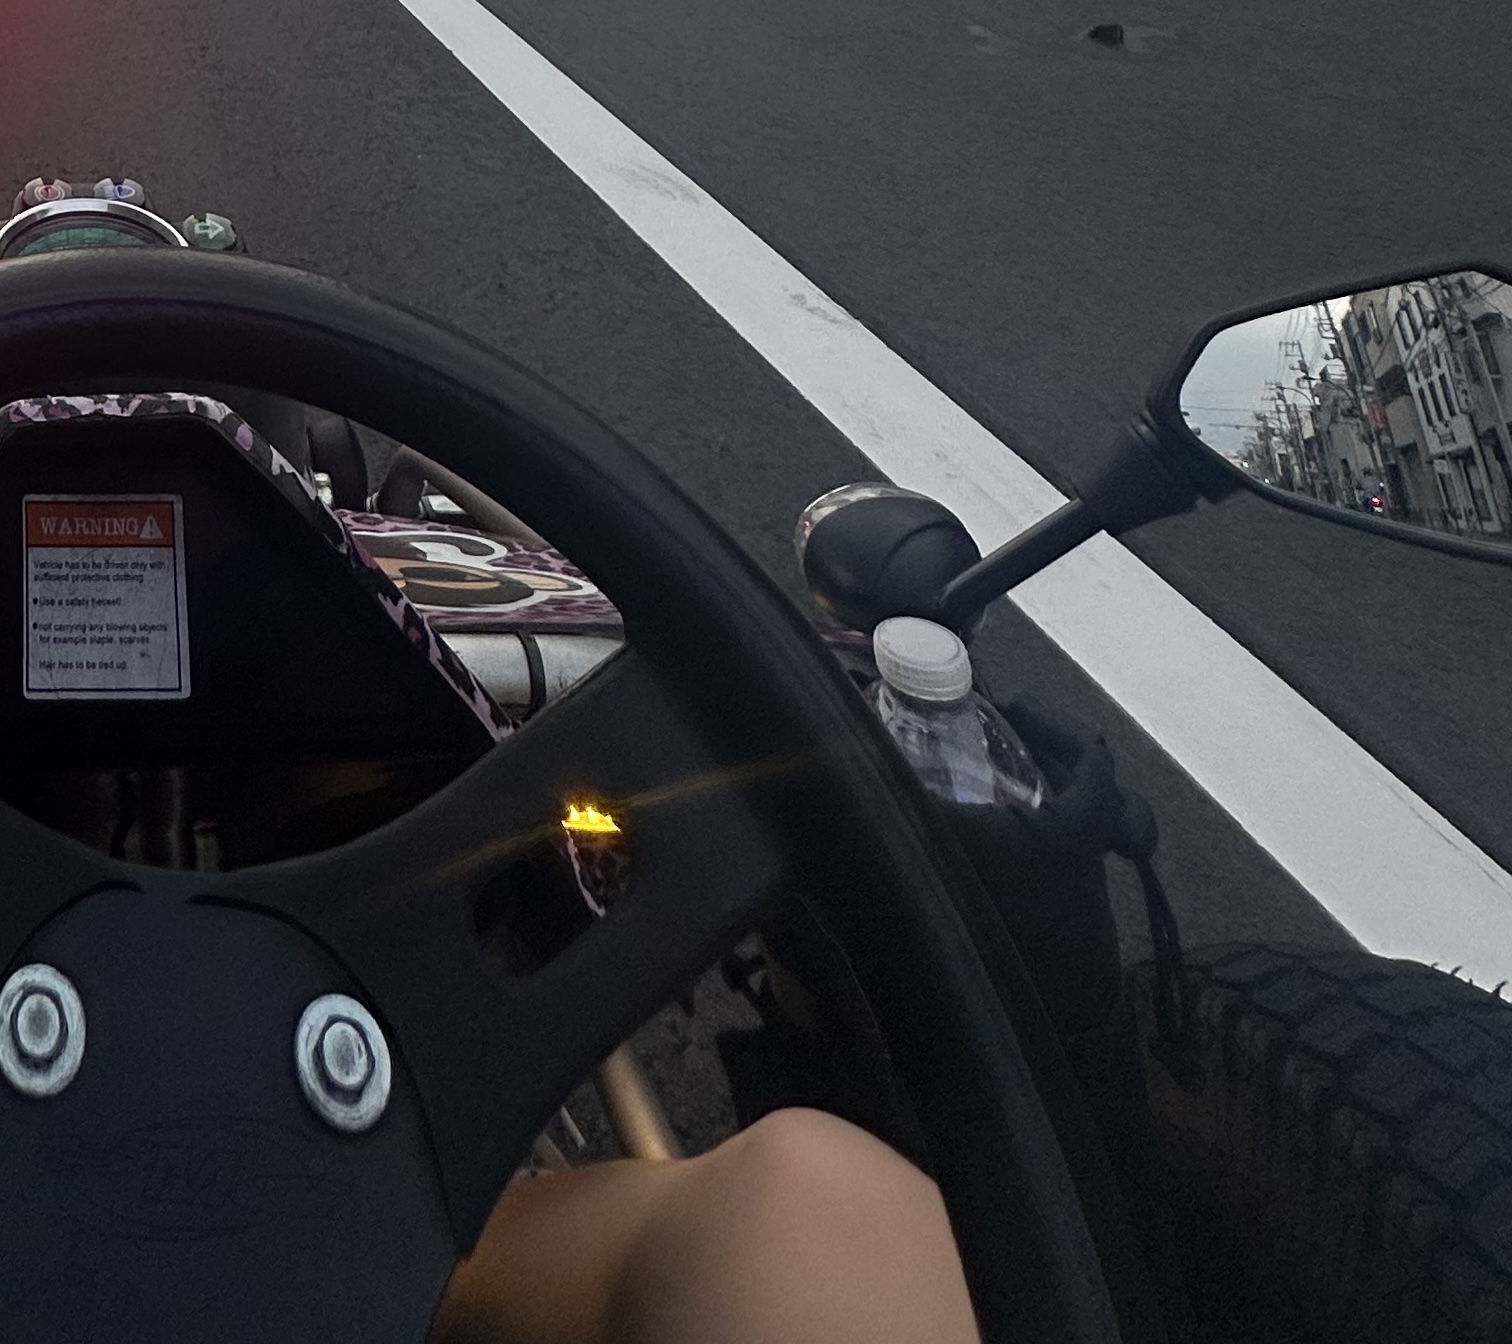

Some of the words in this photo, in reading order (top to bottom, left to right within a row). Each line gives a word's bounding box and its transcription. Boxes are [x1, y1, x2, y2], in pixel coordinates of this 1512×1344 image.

[40, 516, 139, 536] WARNING
[64, 560, 80, 570] has
[82, 560, 91, 570] to
[91, 560, 102, 570] be
[39, 597, 55, 606] Use
[65, 597, 89, 608] safety
[53, 624, 87, 635] carrying
[88, 625, 104, 634] any
[39, 635, 50, 644] for
[52, 636, 87, 646] example
[39, 661, 56, 670] Hair
[58, 661, 74, 669] has
[86, 661, 97, 669] be
